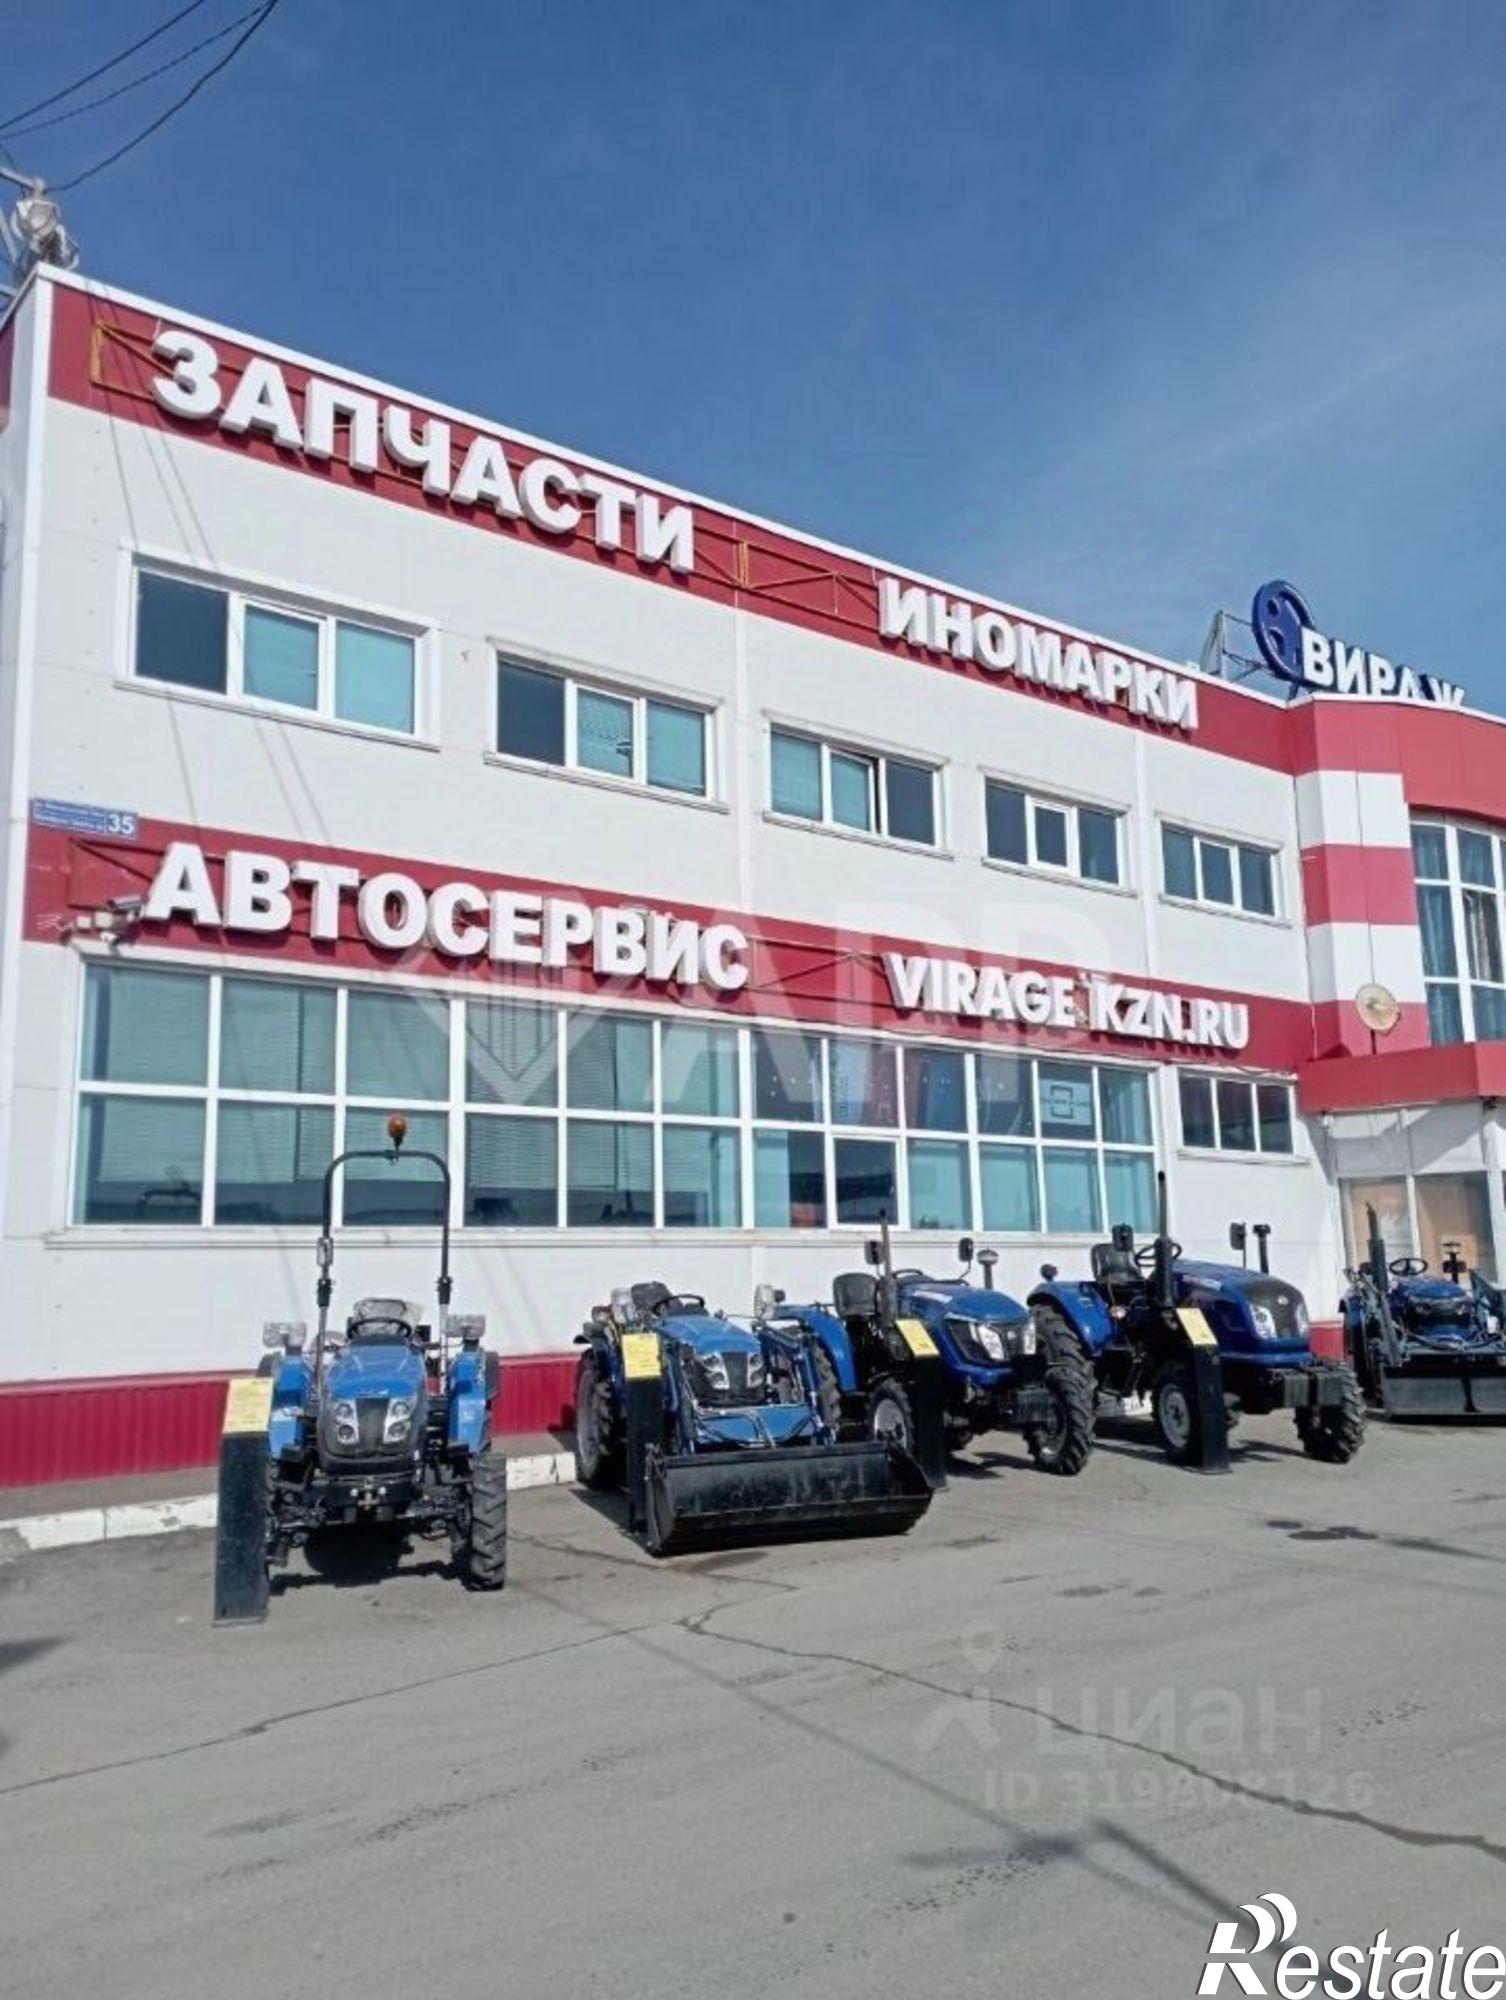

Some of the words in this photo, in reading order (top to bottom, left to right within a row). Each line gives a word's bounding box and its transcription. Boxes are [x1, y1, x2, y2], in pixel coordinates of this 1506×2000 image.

[151, 329, 694, 573] ЗАПЧАСТИ
[878, 577, 1198, 730] ИНОМАРКИ
[107, 814, 135, 834] 35
[141, 841, 749, 991] АВТОСЕРВИС
